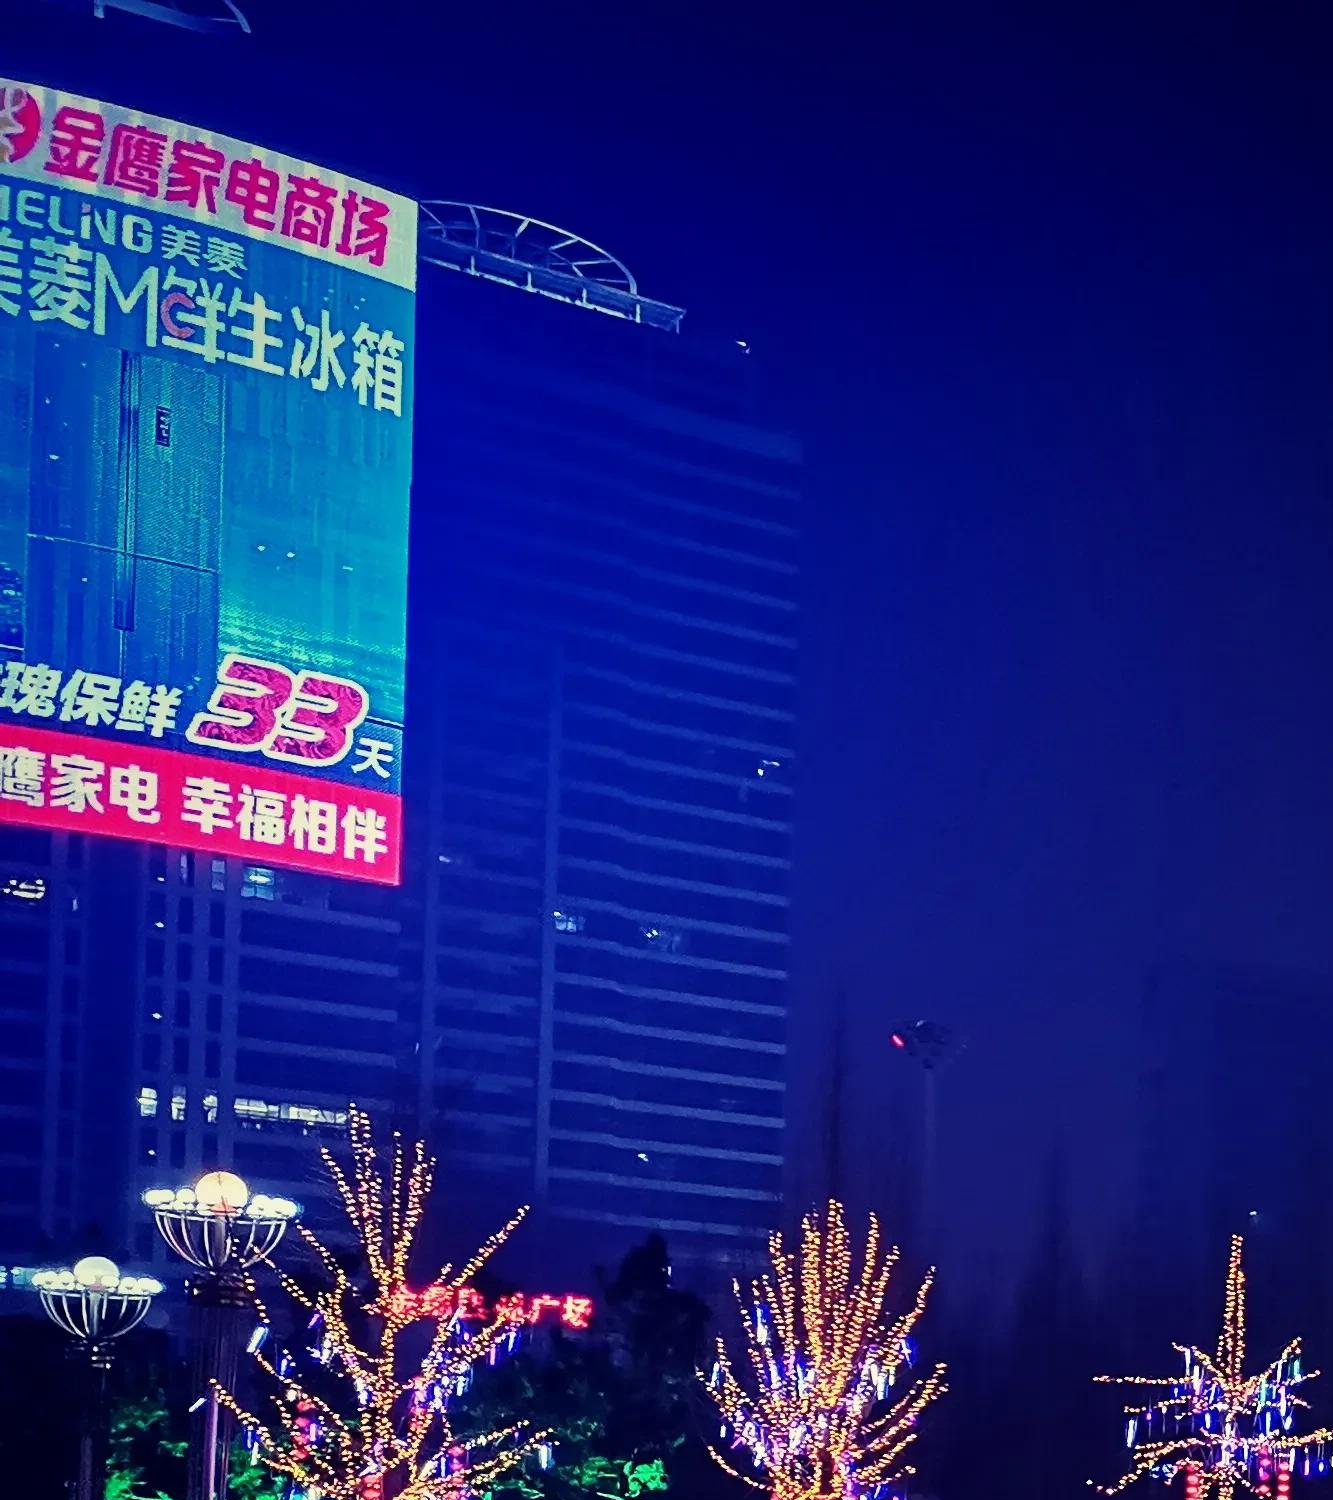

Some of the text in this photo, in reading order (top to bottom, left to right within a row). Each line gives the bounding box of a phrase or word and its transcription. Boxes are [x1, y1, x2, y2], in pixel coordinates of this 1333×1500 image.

[44, 105, 390, 267] 金鹰家电商场
[161, 223, 248, 280] 美菱
[181, 777, 388, 864] 幸福相伴
